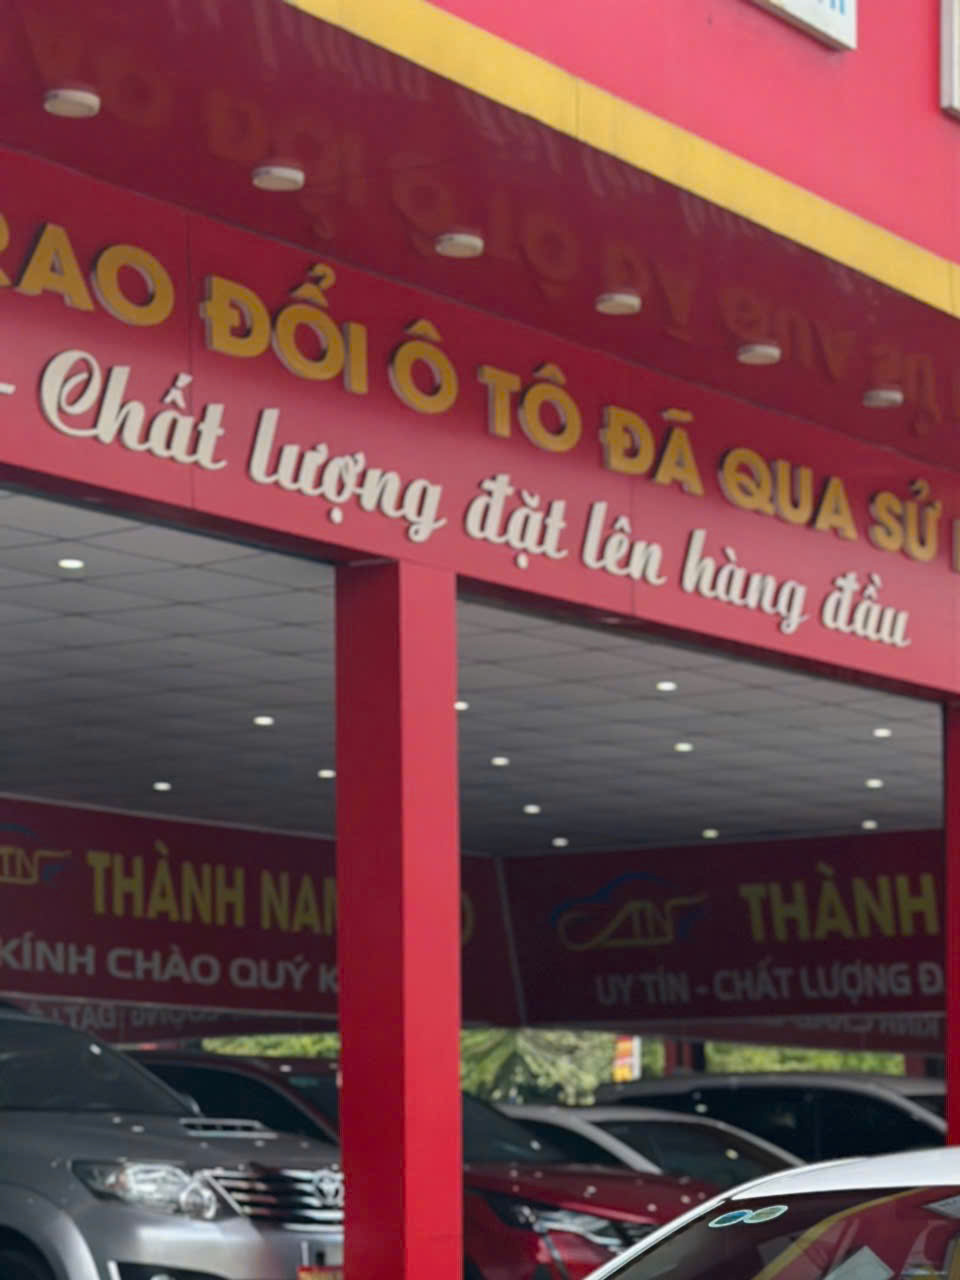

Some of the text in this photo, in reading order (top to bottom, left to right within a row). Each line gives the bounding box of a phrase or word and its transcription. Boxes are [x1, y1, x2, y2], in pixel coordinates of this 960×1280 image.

[0, 211, 175, 326] AO
[200, 264, 368, 394] ĐỔI
[389, 320, 458, 414] Ô
[478, 364, 582, 452] TÔ
[600, 405, 704, 497] ĐÃ
[719, 448, 857, 542] QUA
[869, 480, 942, 563] SỬ
[39, 349, 228, 470] Chất
[249, 407, 447, 543] lượng
[465, 473, 568, 569] đặt
[582, 500, 668, 586] lên
[682, 529, 810, 635] hàng
[821, 571, 912, 648] đầu
[86, 838, 245, 928] THÀNH
[737, 861, 940, 943] THÀNH
[0, 931, 97, 976] KÍNH
[107, 943, 221, 986] CHÀO
[229, 952, 311, 992] QUÝ
[713, 953, 794, 1003] CHẤT
[800, 958, 912, 1006] LƯỢNG
